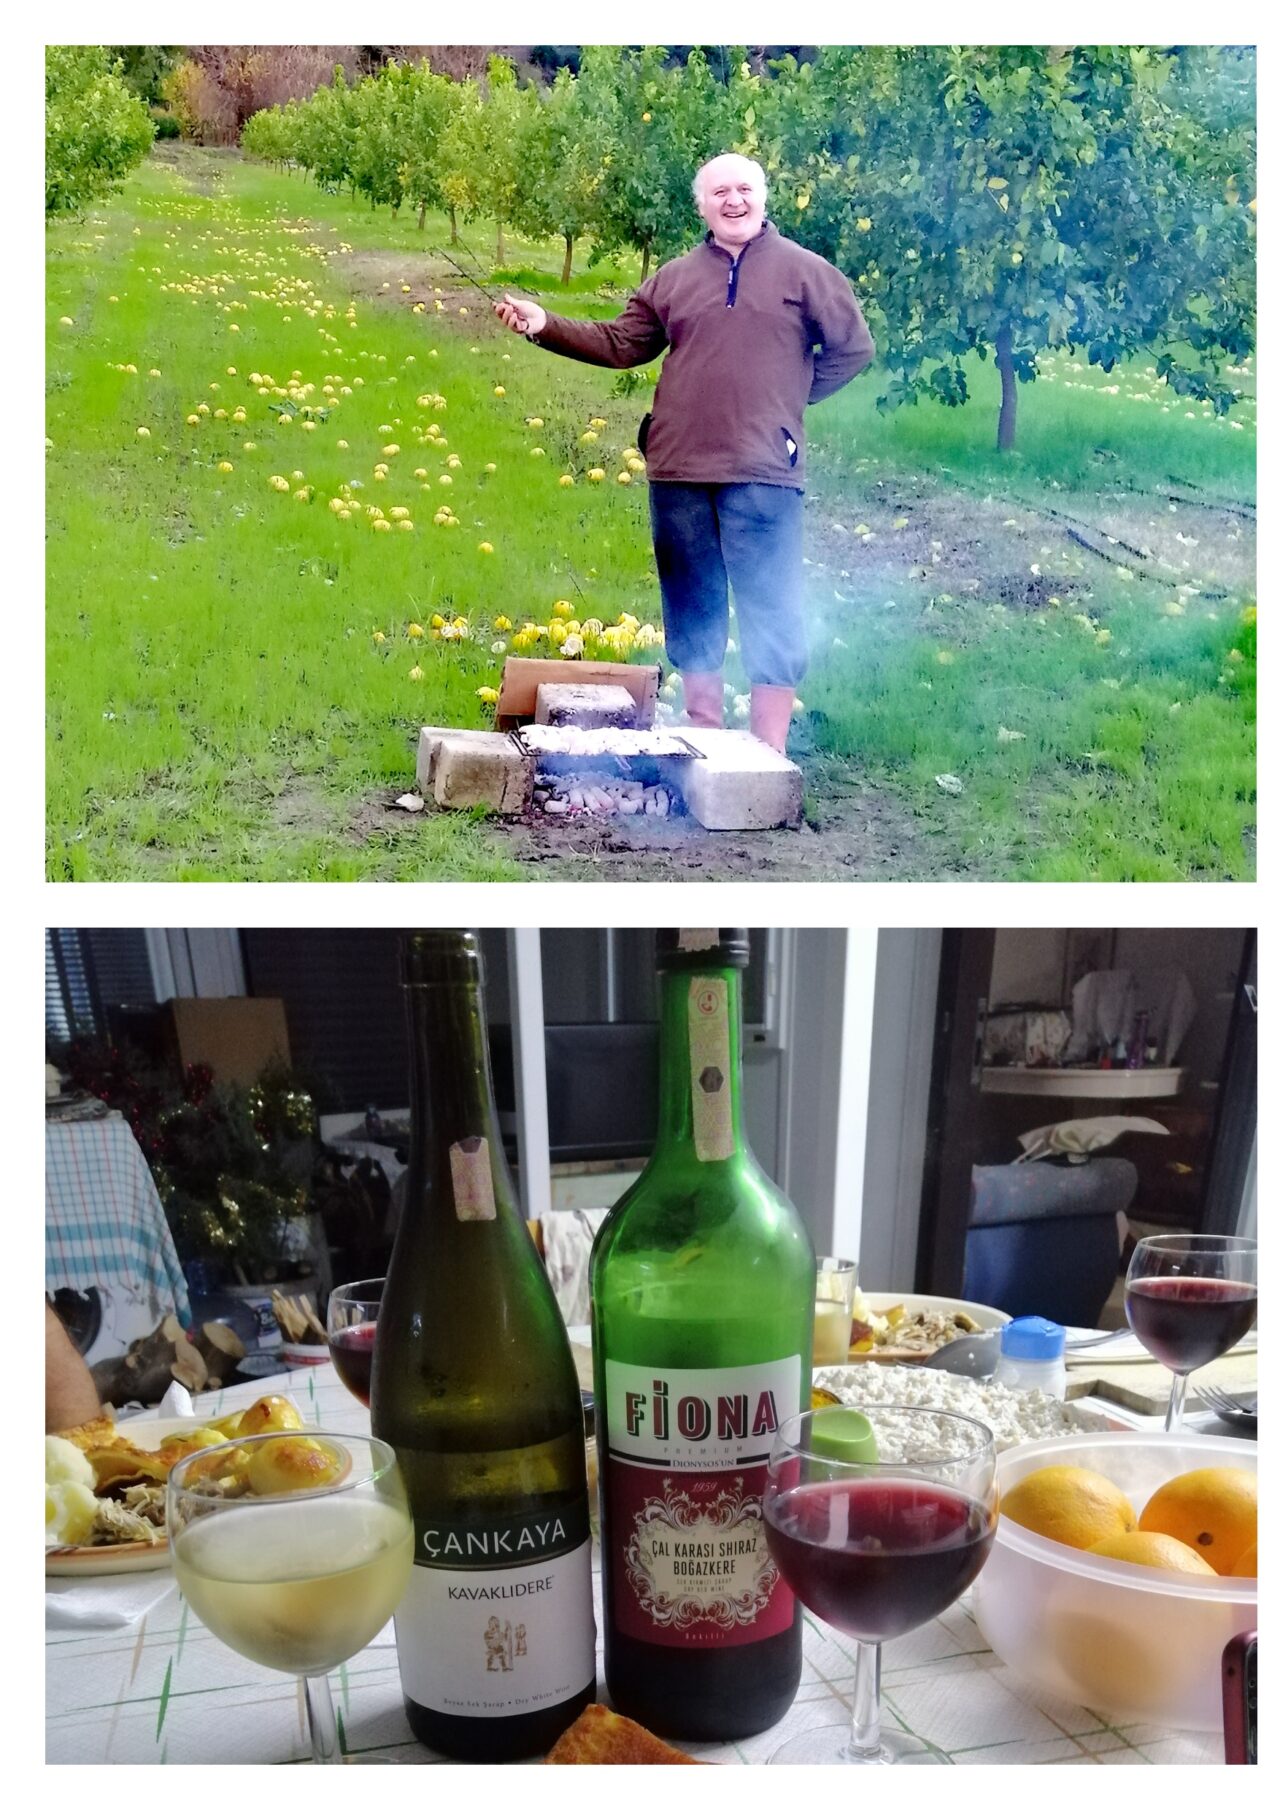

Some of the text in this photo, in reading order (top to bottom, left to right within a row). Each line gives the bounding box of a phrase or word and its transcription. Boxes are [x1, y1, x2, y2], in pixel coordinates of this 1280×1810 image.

[423, 1518, 566, 1558] ÇANKAYA
[652, 1537, 757, 1558] ÇAL KARASI SHIRAZ
[673, 1559, 736, 1576] BOĞAZKERE
[447, 1576, 554, 1600] KAVAKLIDERE
